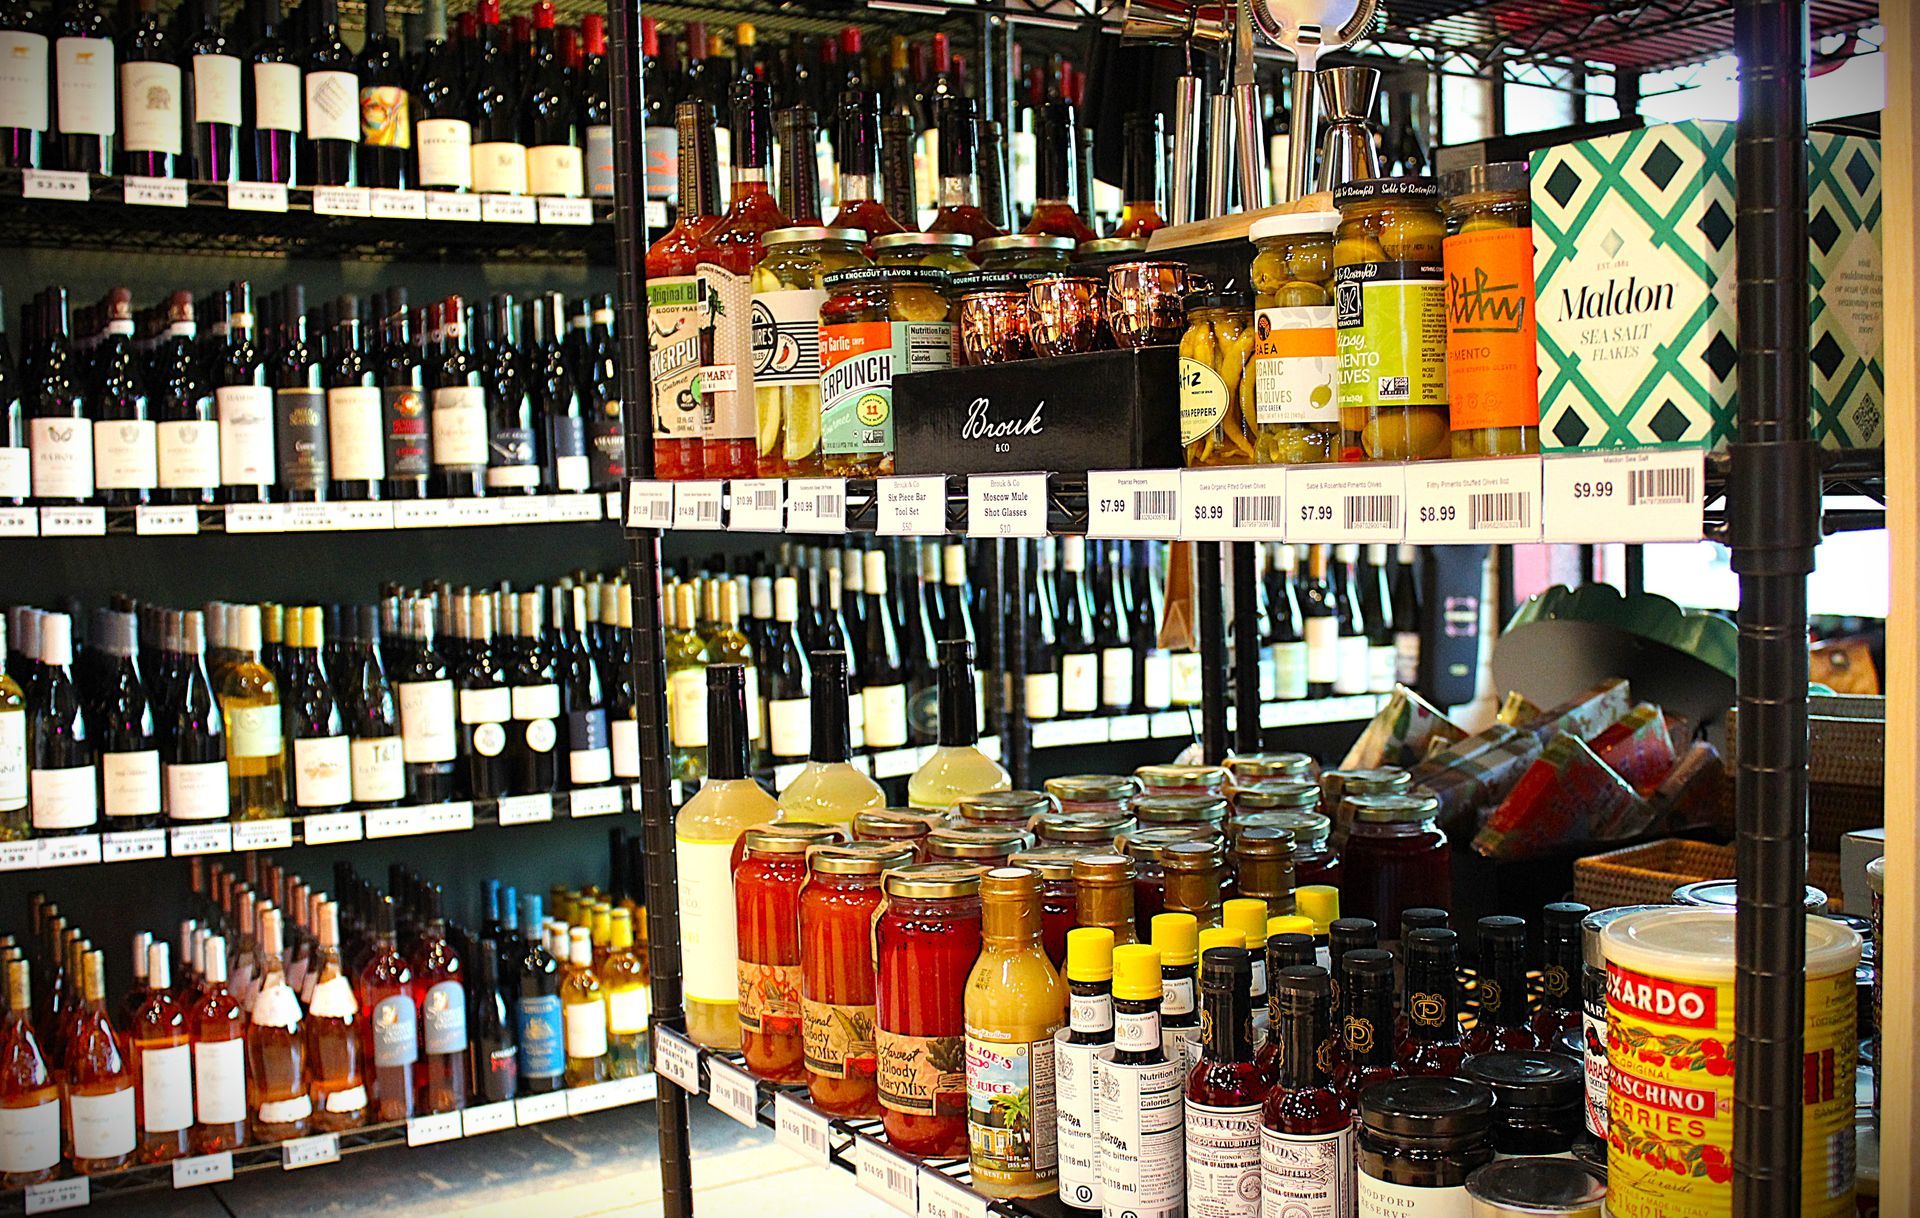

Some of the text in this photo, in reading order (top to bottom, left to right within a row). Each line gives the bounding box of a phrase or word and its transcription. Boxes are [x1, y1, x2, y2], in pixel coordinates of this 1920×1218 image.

[845, 270, 880, 280] KNOCKOUT
[953, 273, 1010, 284] GOURMET PICKLES
[653, 283, 697, 303] Original Bl
[1558, 276, 1674, 322] Maldon
[910, 326, 938, 335] Nutrition
[1580, 324, 1652, 345] SEA SALT
[828, 335, 851, 352] Garlic
[912, 354, 931, 362] Calories
[1592, 346, 1640, 361] FLAKES
[823, 355, 890, 403] ERPUNCH
[1263, 390, 1292, 404] OLIVES
[866, 405, 878, 415] 11
[1190, 407, 1217, 418] PEPPERS
[962, 397, 1045, 439] Brouk
[995, 443, 1010, 452] & CO
[888, 492, 927, 501] Six Piece Bar
[983, 491, 1028, 501] Moscow Mule
[1574, 482, 1613, 498] $9.99
[793, 501, 813, 512] $10.99
[895, 507, 919, 516] Tool Set
[984, 507, 1027, 516] Shot Glasses
[1100, 499, 1125, 512] $7.99
[1194, 505, 1223, 519] $8.99
[1301, 505, 1332, 520] $7.99
[1420, 506, 1456, 522] $8.99
[1000, 524, 1011, 533] $10
[880, 1042, 923, 1062] Harvest
[977, 1046, 1013, 1069] JOE'S
[882, 1056, 917, 1083] Bloody
[1140, 1069, 1173, 1081] Nutrition
[1621, 1058, 1671, 1081] ORIGINAL
[880, 1075, 927, 1097] Mary Mix
[976, 1081, 1012, 1094] JUICE
[1140, 1098, 1171, 1107] Calories
[782, 1119, 800, 1135] $14.99
[1067, 1129, 1092, 1138] bitters
[1112, 1152, 1138, 1162] bitters
[863, 1161, 884, 1179] $14.99
[1036, 1171, 1046, 1179] NO
[1122, 1182, 1137, 1193] mL)
